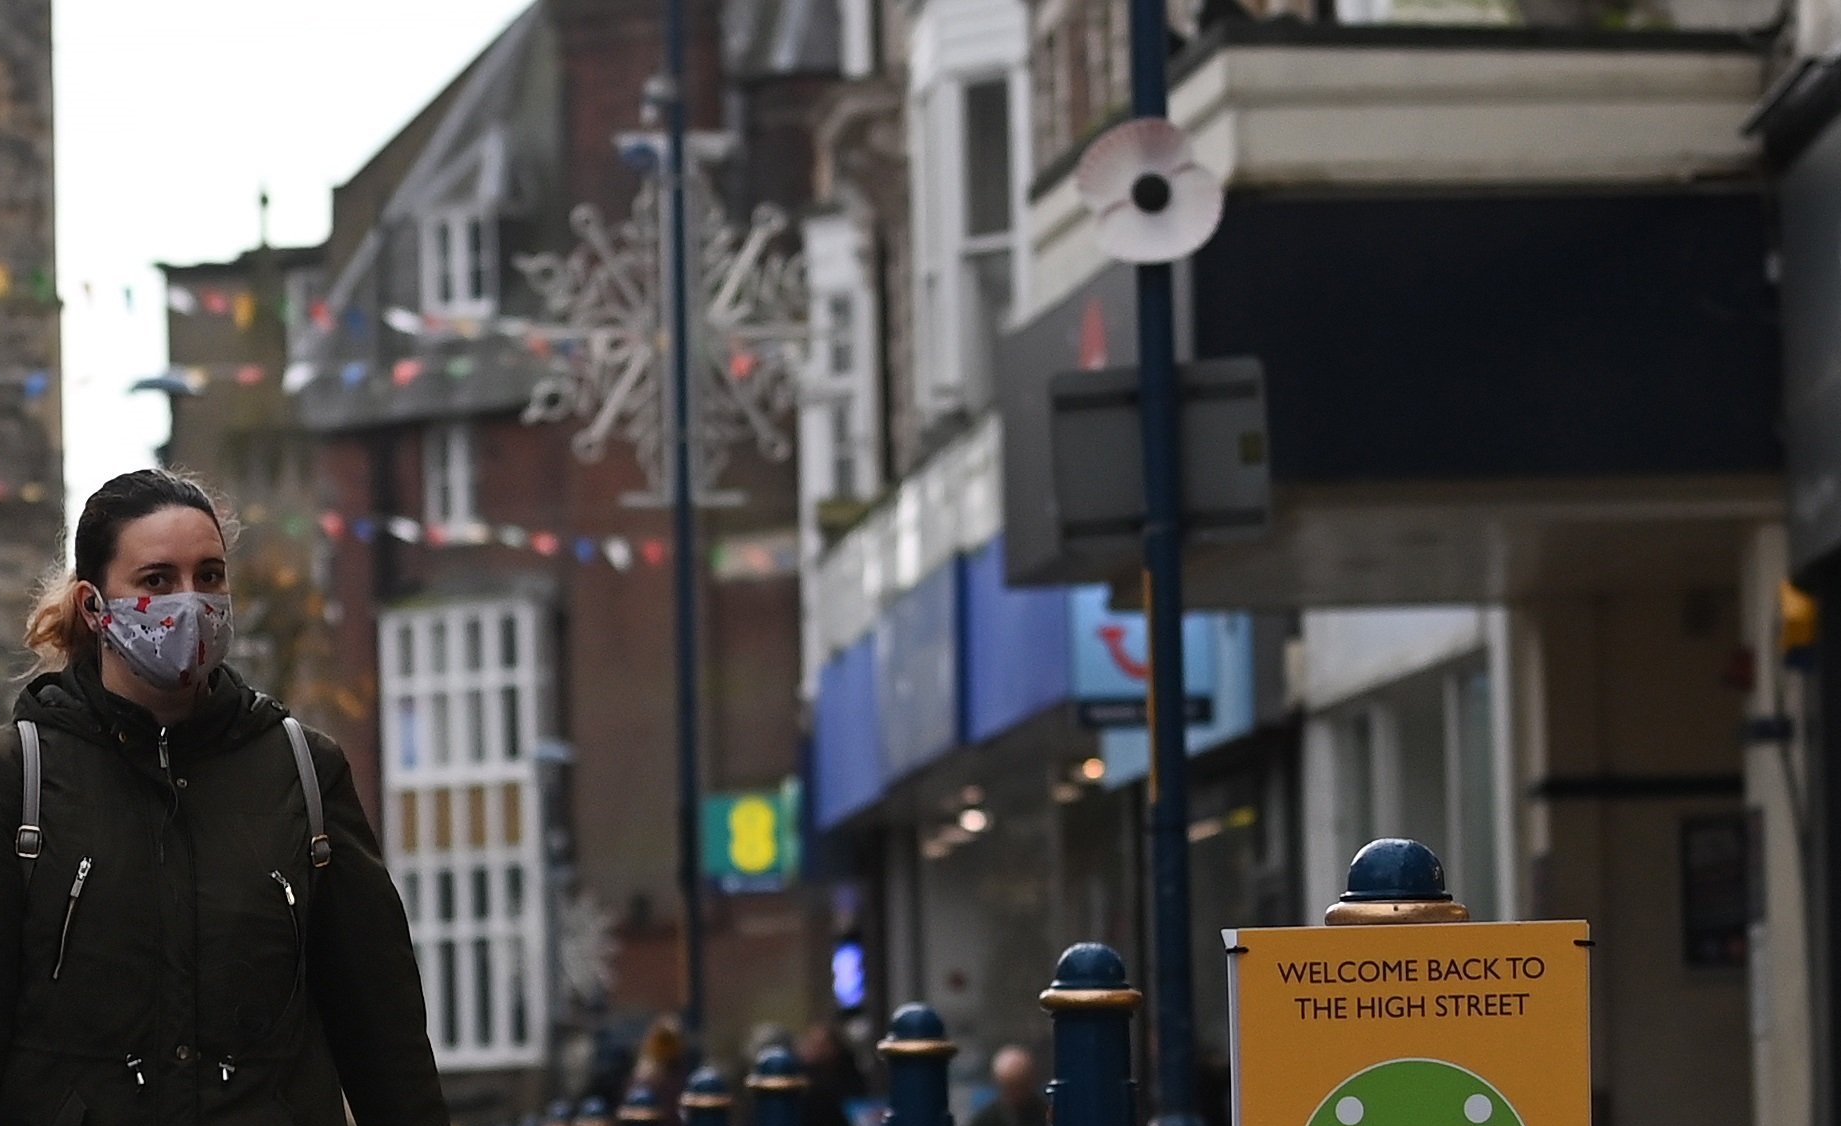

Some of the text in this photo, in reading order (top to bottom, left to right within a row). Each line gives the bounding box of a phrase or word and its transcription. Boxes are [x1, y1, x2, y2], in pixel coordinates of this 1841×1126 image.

[1278, 957, 1544, 983] WELCOME BACK TO
[1295, 993, 1529, 1019] THE HIGH STREET
